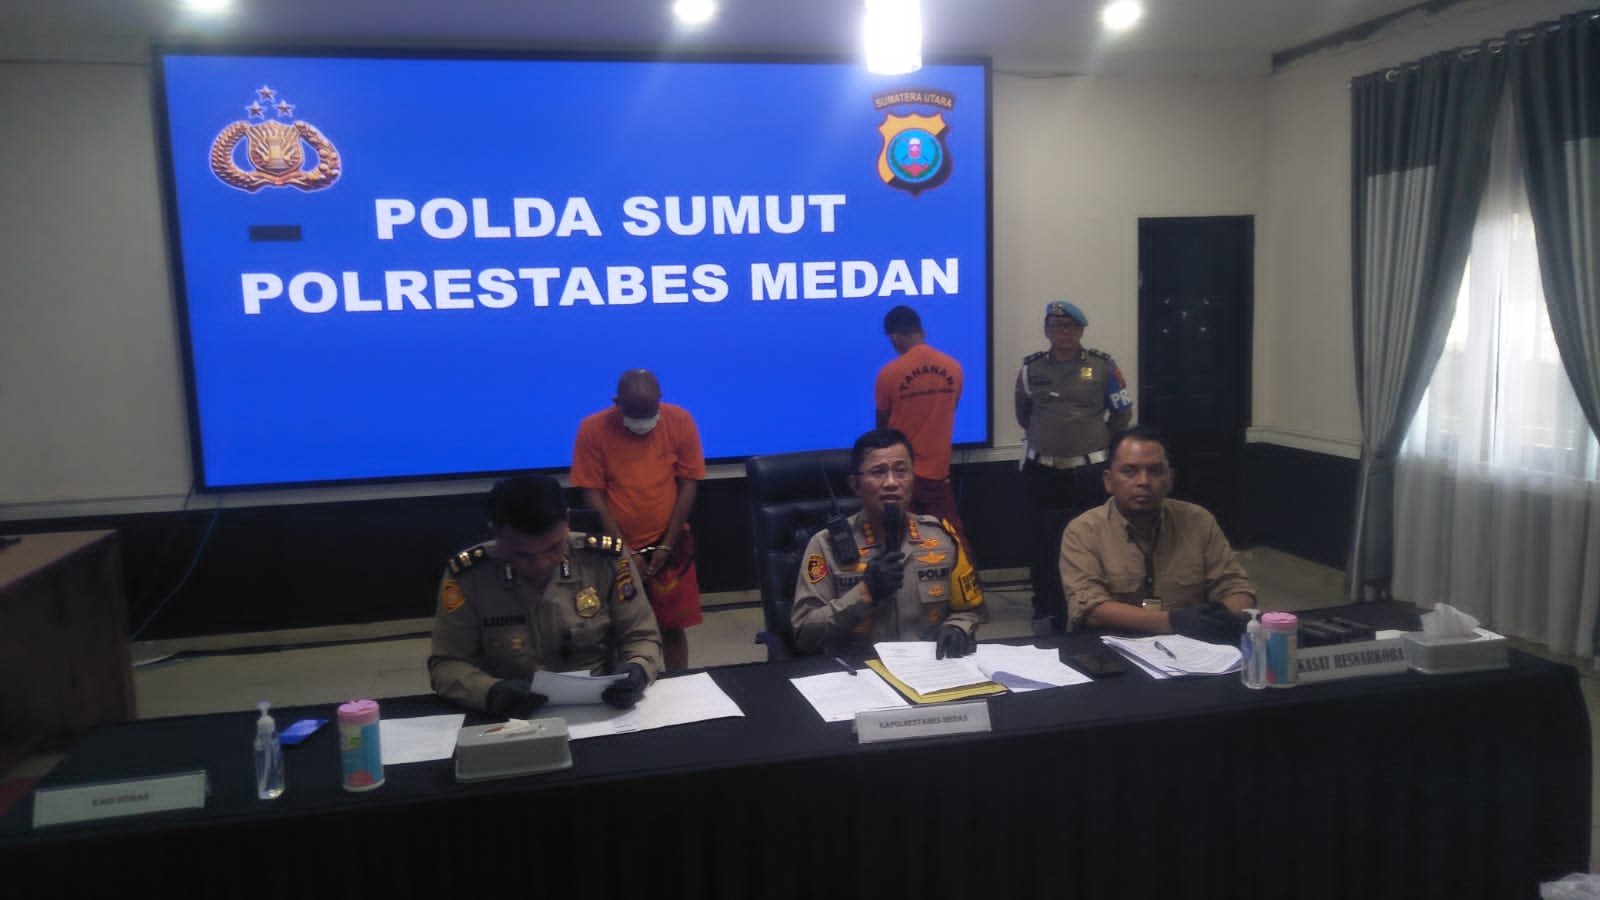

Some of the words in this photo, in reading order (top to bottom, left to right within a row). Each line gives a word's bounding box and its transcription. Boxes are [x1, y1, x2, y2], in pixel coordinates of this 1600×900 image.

[874, 91, 922, 109] SUMATERA
[924, 93, 953, 109] UTARA
[375, 197, 603, 240] POLDA
[622, 194, 846, 237] SUMUT
[241, 263, 729, 315] POLRESTABES
[750, 257, 960, 301] MEDAN
[899, 365, 955, 392] TAHANAN
